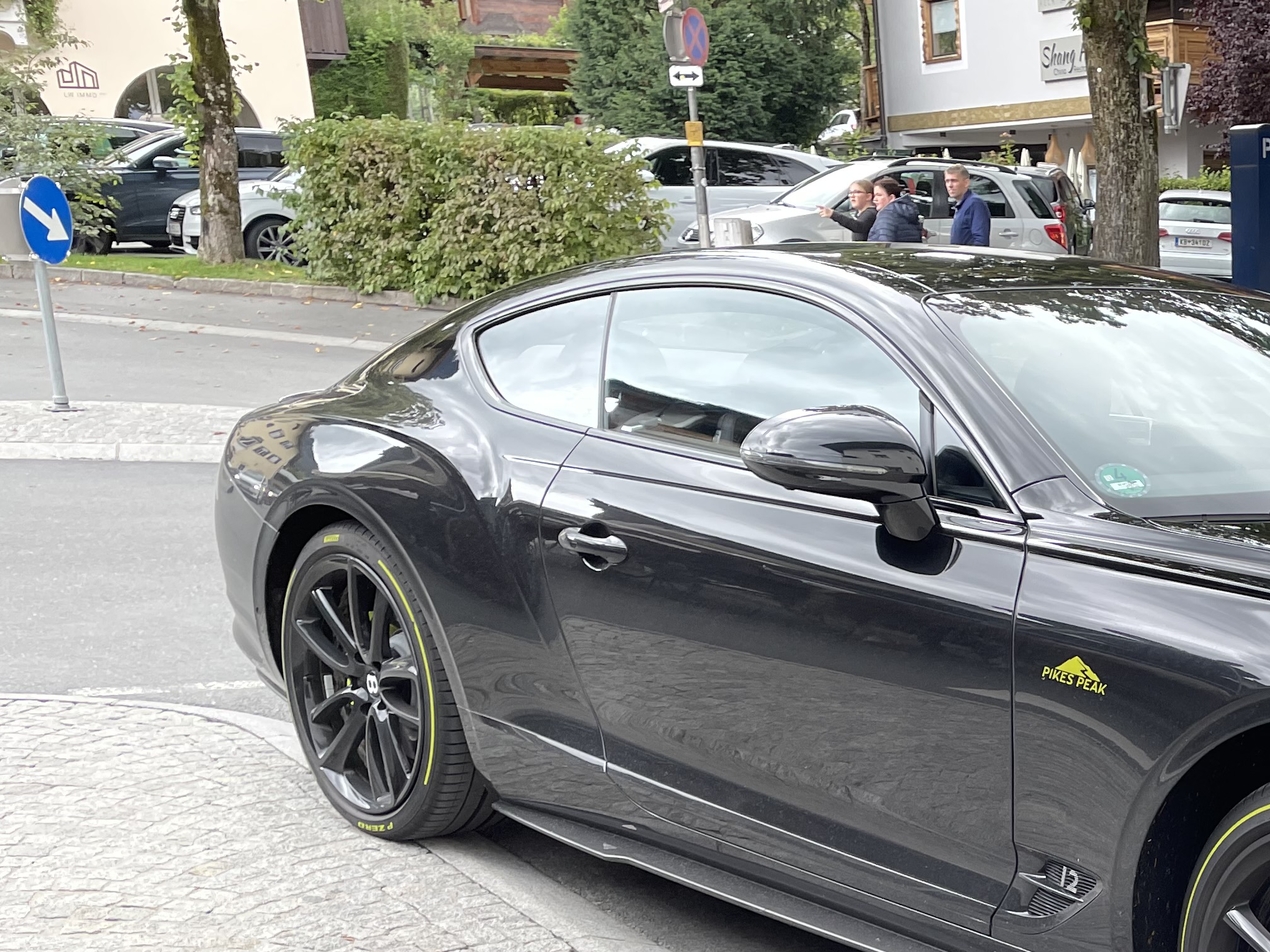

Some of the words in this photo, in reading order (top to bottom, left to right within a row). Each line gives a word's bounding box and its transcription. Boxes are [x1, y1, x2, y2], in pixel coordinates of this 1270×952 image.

[1041, 42, 1075, 74] Shang
[1041, 666, 1074, 685] PIKES
[1076, 676, 1107, 696] PEAK
[1060, 866, 1079, 894] 12
